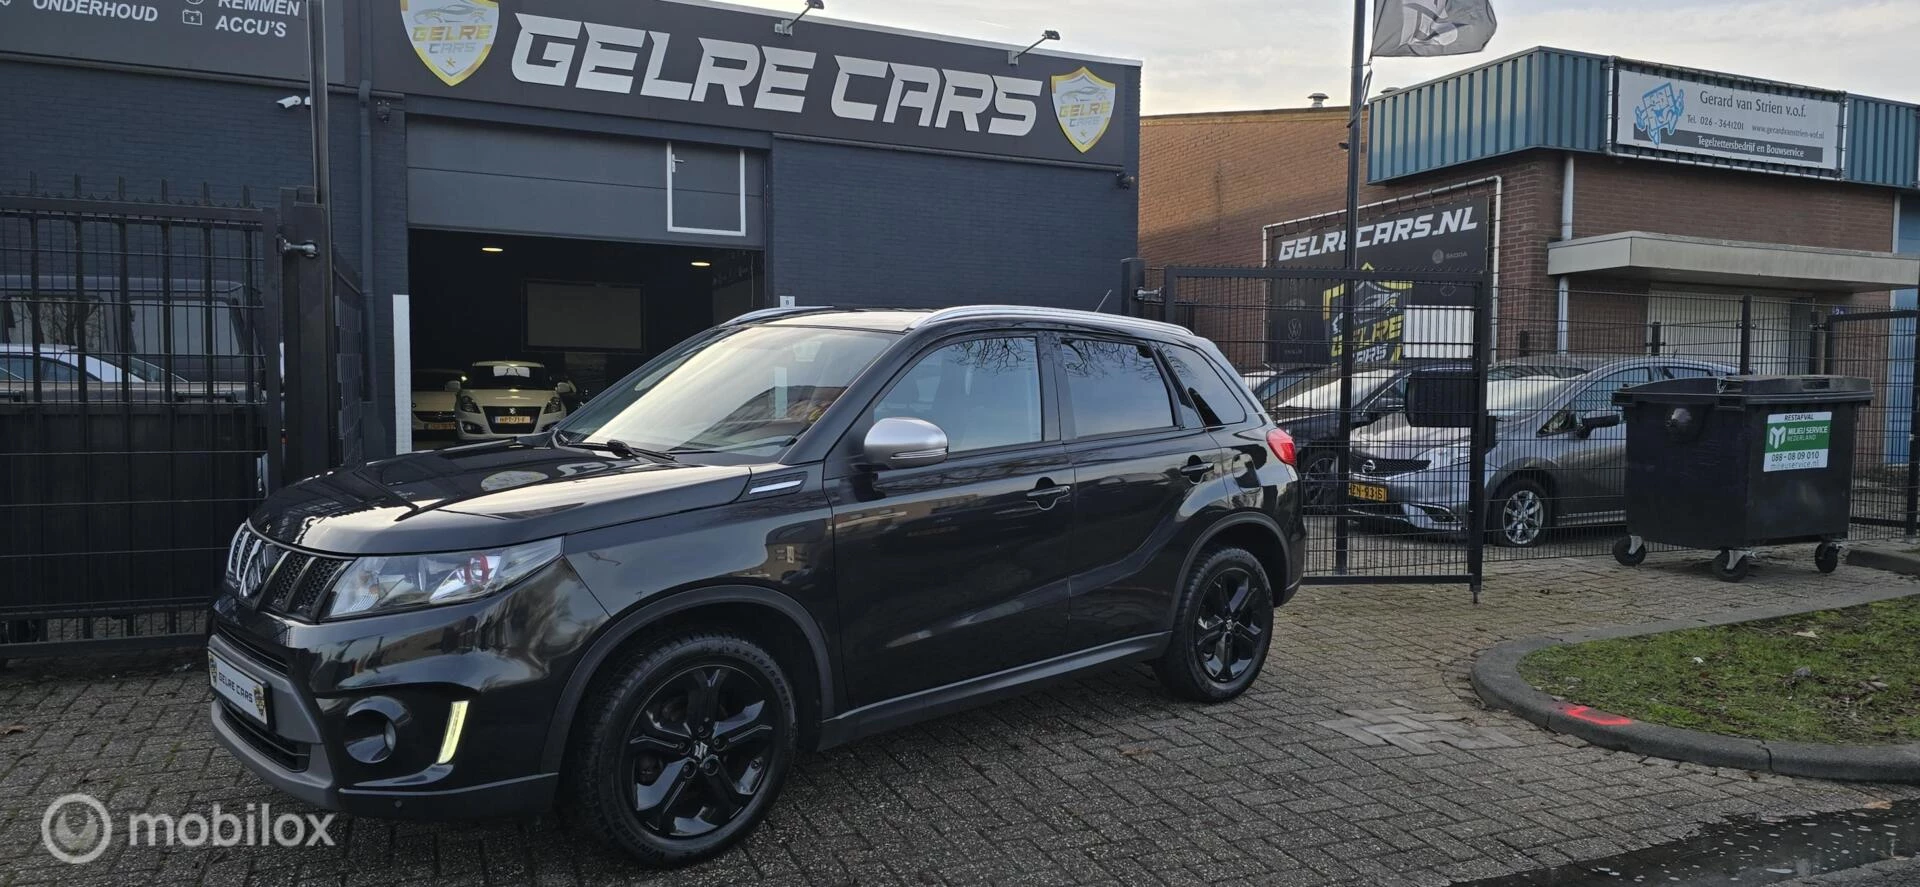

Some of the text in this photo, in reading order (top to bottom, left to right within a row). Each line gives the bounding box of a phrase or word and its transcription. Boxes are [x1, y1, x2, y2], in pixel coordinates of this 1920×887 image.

[33, 0, 158, 22] ONDERHOUD
[215, 15, 287, 38] ACCU'S
[412, 24, 493, 42] GELRE
[428, 42, 477, 55] CARS
[511, 12, 1043, 137] GELRE CARS
[1059, 102, 1111, 117] GELRE
[1700, 90, 1807, 118] Gerard van Strien v.o.f.
[1700, 116, 1713, 126] 026
[1697, 135, 1805, 158] Tegelzettersbedrijf en Bouwservice
[1806, 426, 1828, 434] SERVICE
[1806, 450, 1820, 460] 010
[219, 671, 236, 692] GELRE
[235, 685, 254, 704] CARS
